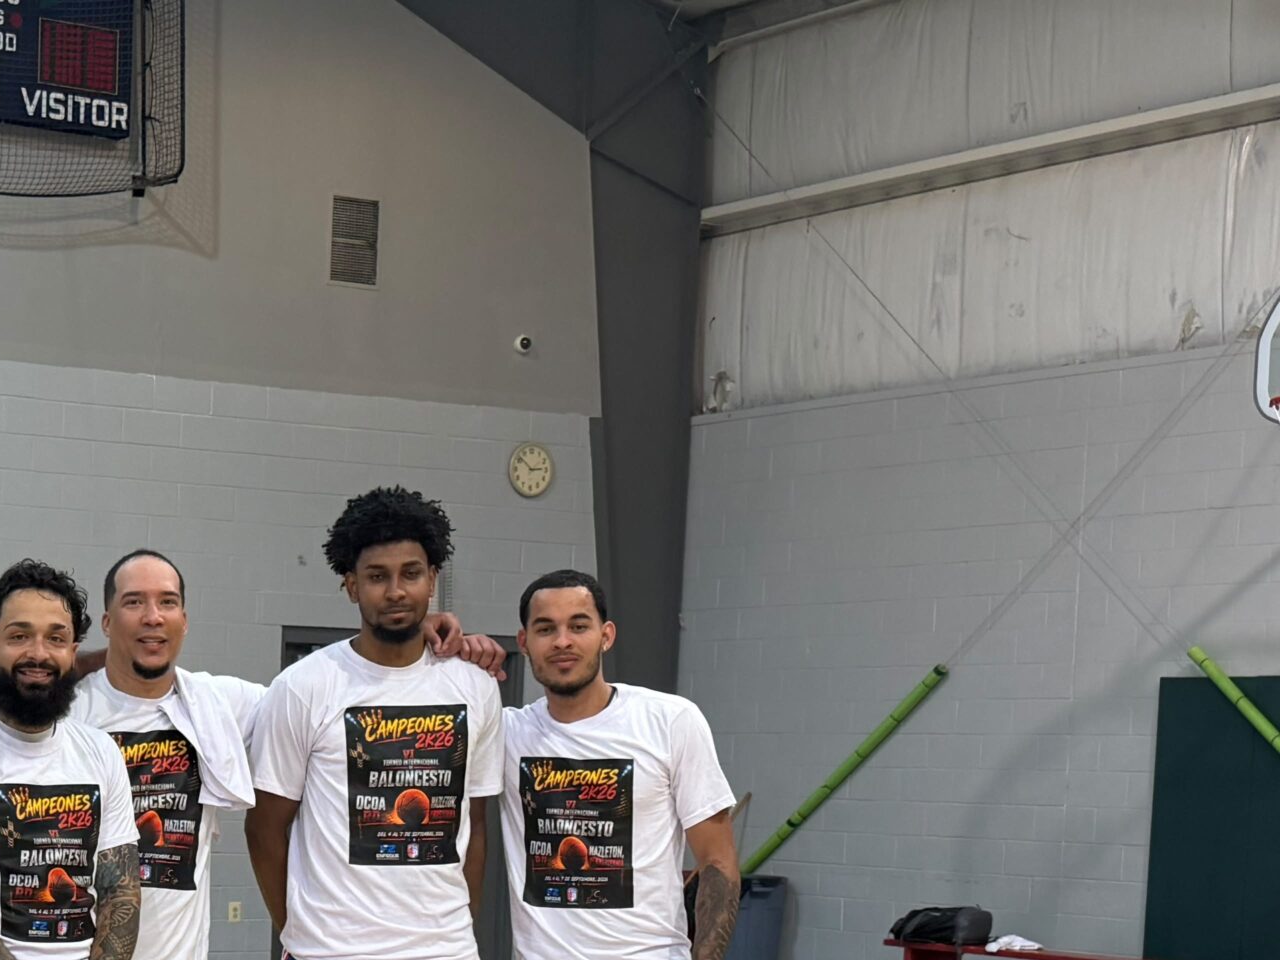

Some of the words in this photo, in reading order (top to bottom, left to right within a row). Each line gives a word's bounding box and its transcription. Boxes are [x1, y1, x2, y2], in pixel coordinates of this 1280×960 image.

[19, 86, 129, 130] VISITOR
[364, 715, 455, 742] CAMPEONES
[415, 730, 454, 749] 2K26
[120, 740, 188, 763] AMPEONES
[151, 755, 190, 774] 2K26
[368, 769, 452, 788] BALONCESTO
[534, 768, 619, 791] CAMPEONES
[578, 783, 619, 800] 2K26
[16, 794, 91, 820] CAMPEONES
[132, 792, 188, 813] ONCESTO
[355, 795, 386, 811] OCOA
[58, 811, 93, 829] 2K26
[537, 818, 615, 838] BALONCESTO
[529, 840, 552, 856] OCOA
[8, 874, 40, 888] OCOA
